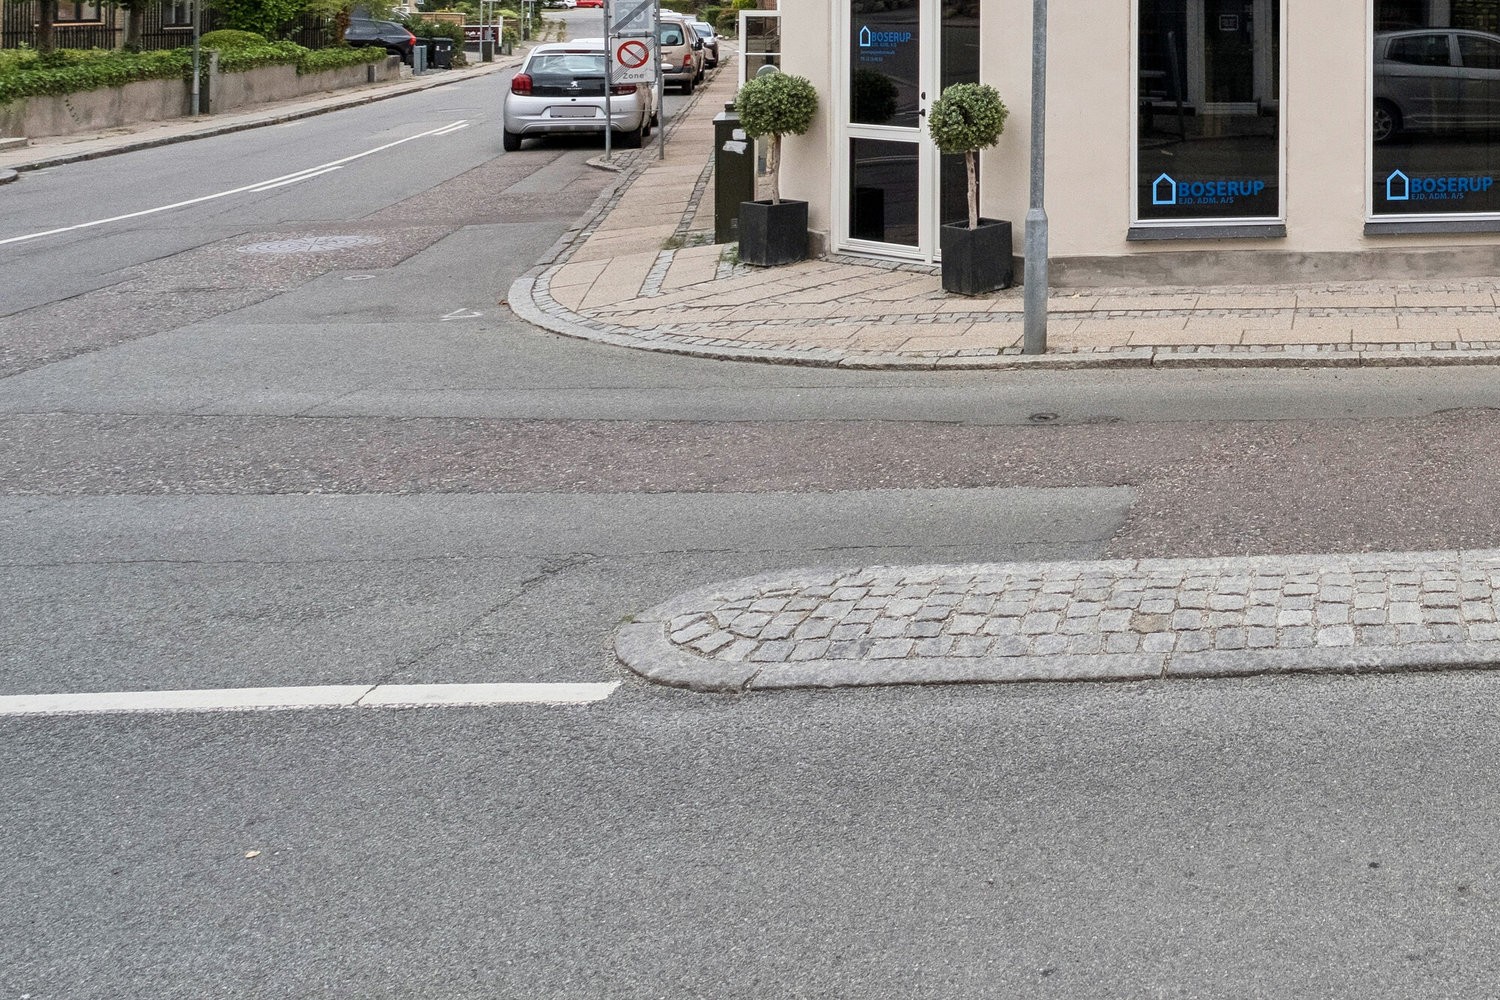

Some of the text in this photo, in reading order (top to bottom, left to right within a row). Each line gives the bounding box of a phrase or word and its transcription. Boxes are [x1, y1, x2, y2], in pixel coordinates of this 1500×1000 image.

[872, 31, 912, 43] BOSERUP
[622, 72, 645, 80] Zone
[1178, 180, 1265, 197] BOSERUP
[1411, 177, 1493, 192] BOSERUP
[1178, 197, 1195, 205] EJD.
[1220, 196, 1234, 204] A/S
